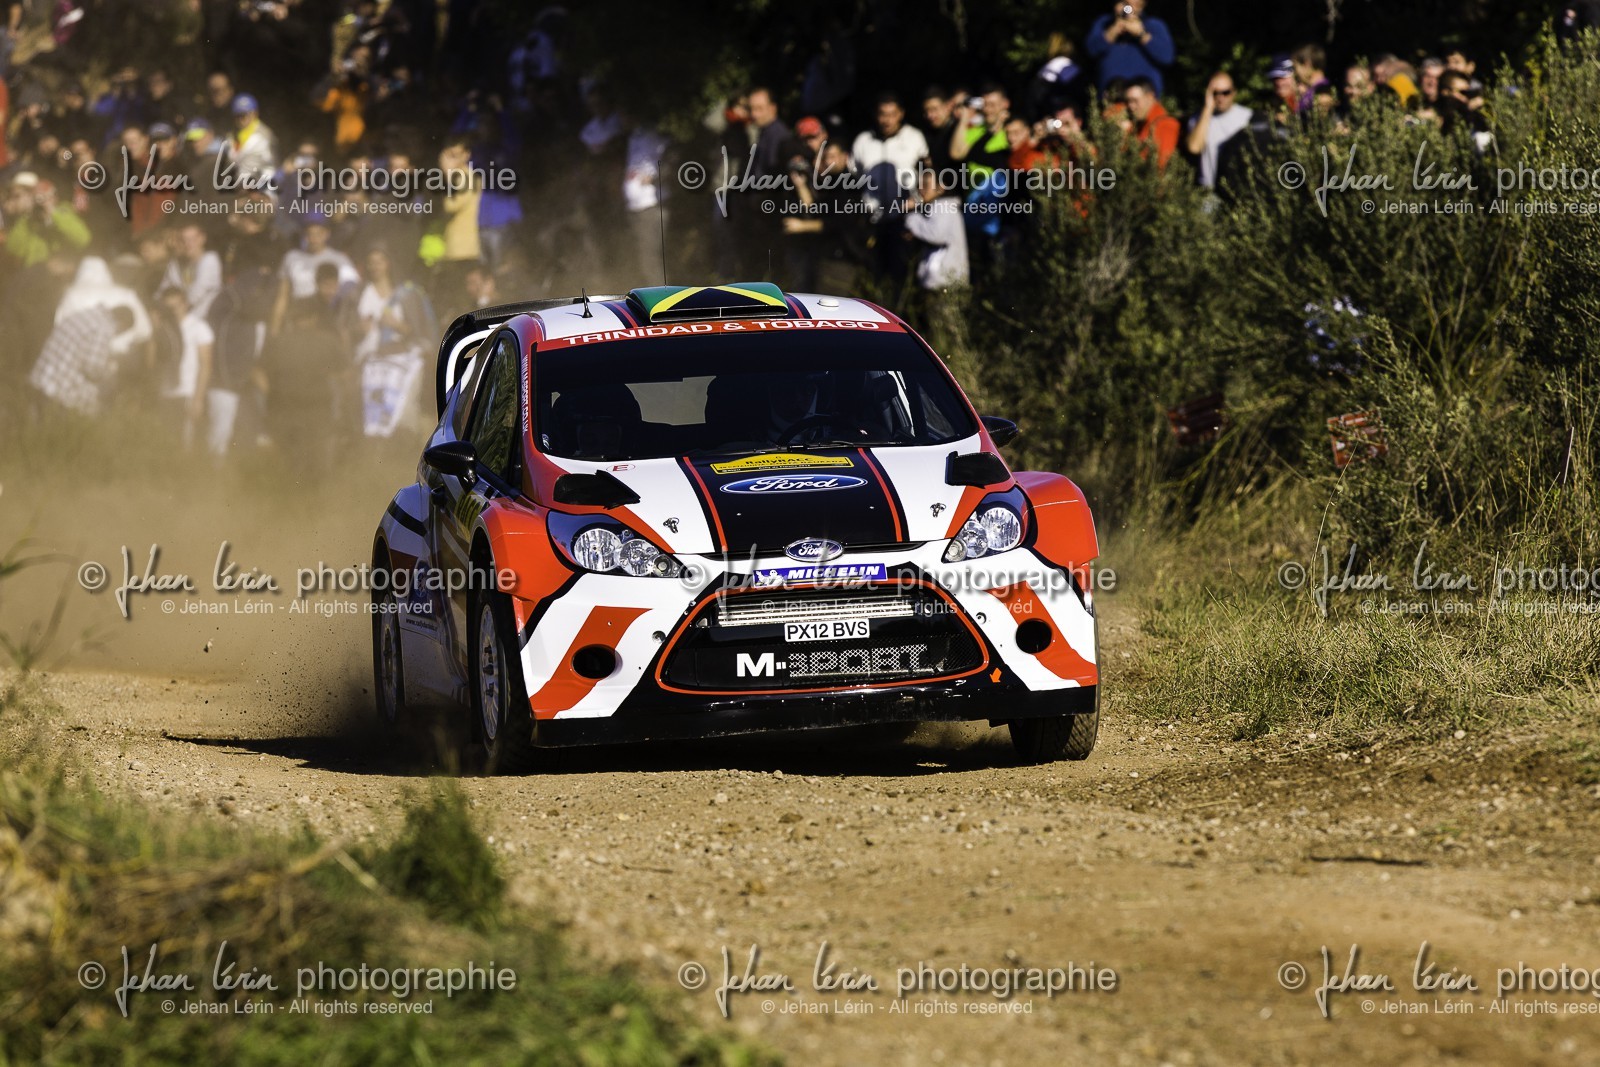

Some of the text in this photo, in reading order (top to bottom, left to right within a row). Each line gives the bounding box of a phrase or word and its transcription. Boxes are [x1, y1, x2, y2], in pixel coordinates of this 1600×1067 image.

[563, 320, 880, 345] TRINIDAD & TOBAGO
[749, 477, 839, 491] Ford
[787, 565, 880, 580] MICHELIN
[787, 621, 868, 640] PX12 BVS
